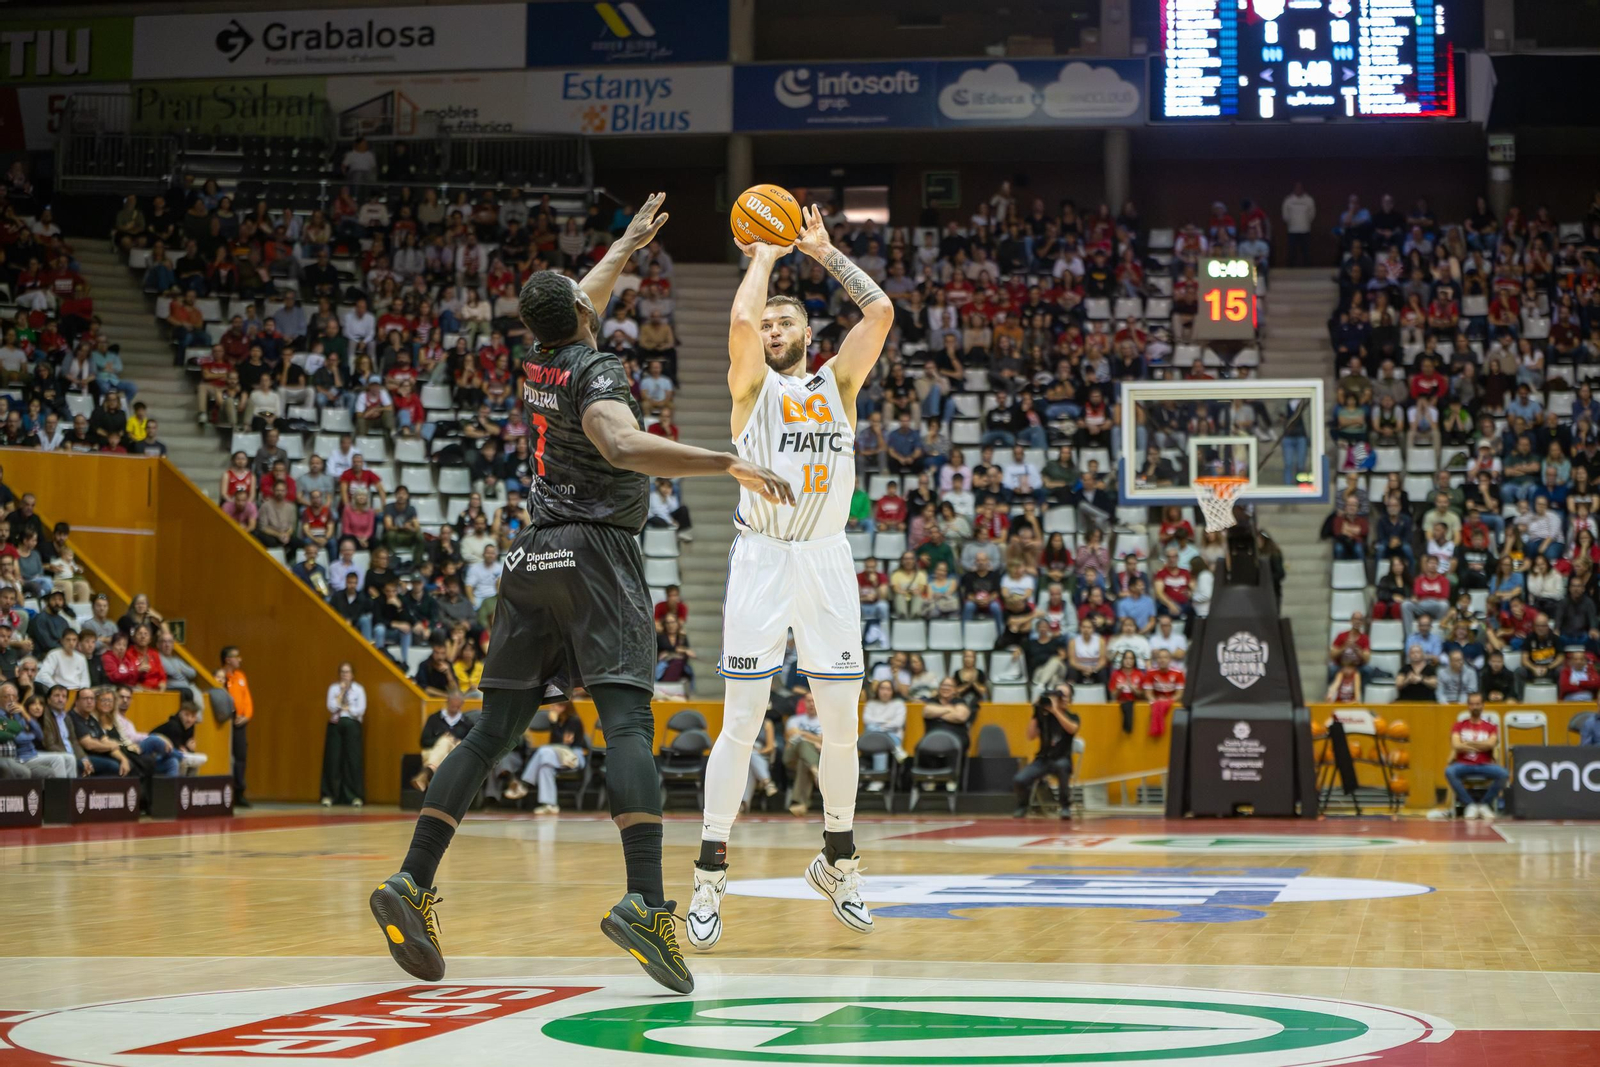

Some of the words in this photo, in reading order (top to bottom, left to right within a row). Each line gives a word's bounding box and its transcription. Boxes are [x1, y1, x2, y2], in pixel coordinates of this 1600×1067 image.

[262, 19, 436, 51] Grabalosa
[562, 72, 673, 106] Estanys
[817, 70, 919, 95] infosoft
[611, 104, 691, 131] Blaus
[746, 195, 785, 233] Wilson
[1204, 289, 1248, 322] 15
[782, 393, 834, 425] BG
[778, 432, 843, 453] FIATC
[802, 464, 829, 494] 12
[526, 549, 574, 563] Diputación
[526, 562, 538, 572] de
[538, 559, 576, 571] Granada
[728, 655, 759, 670] YOSOY
